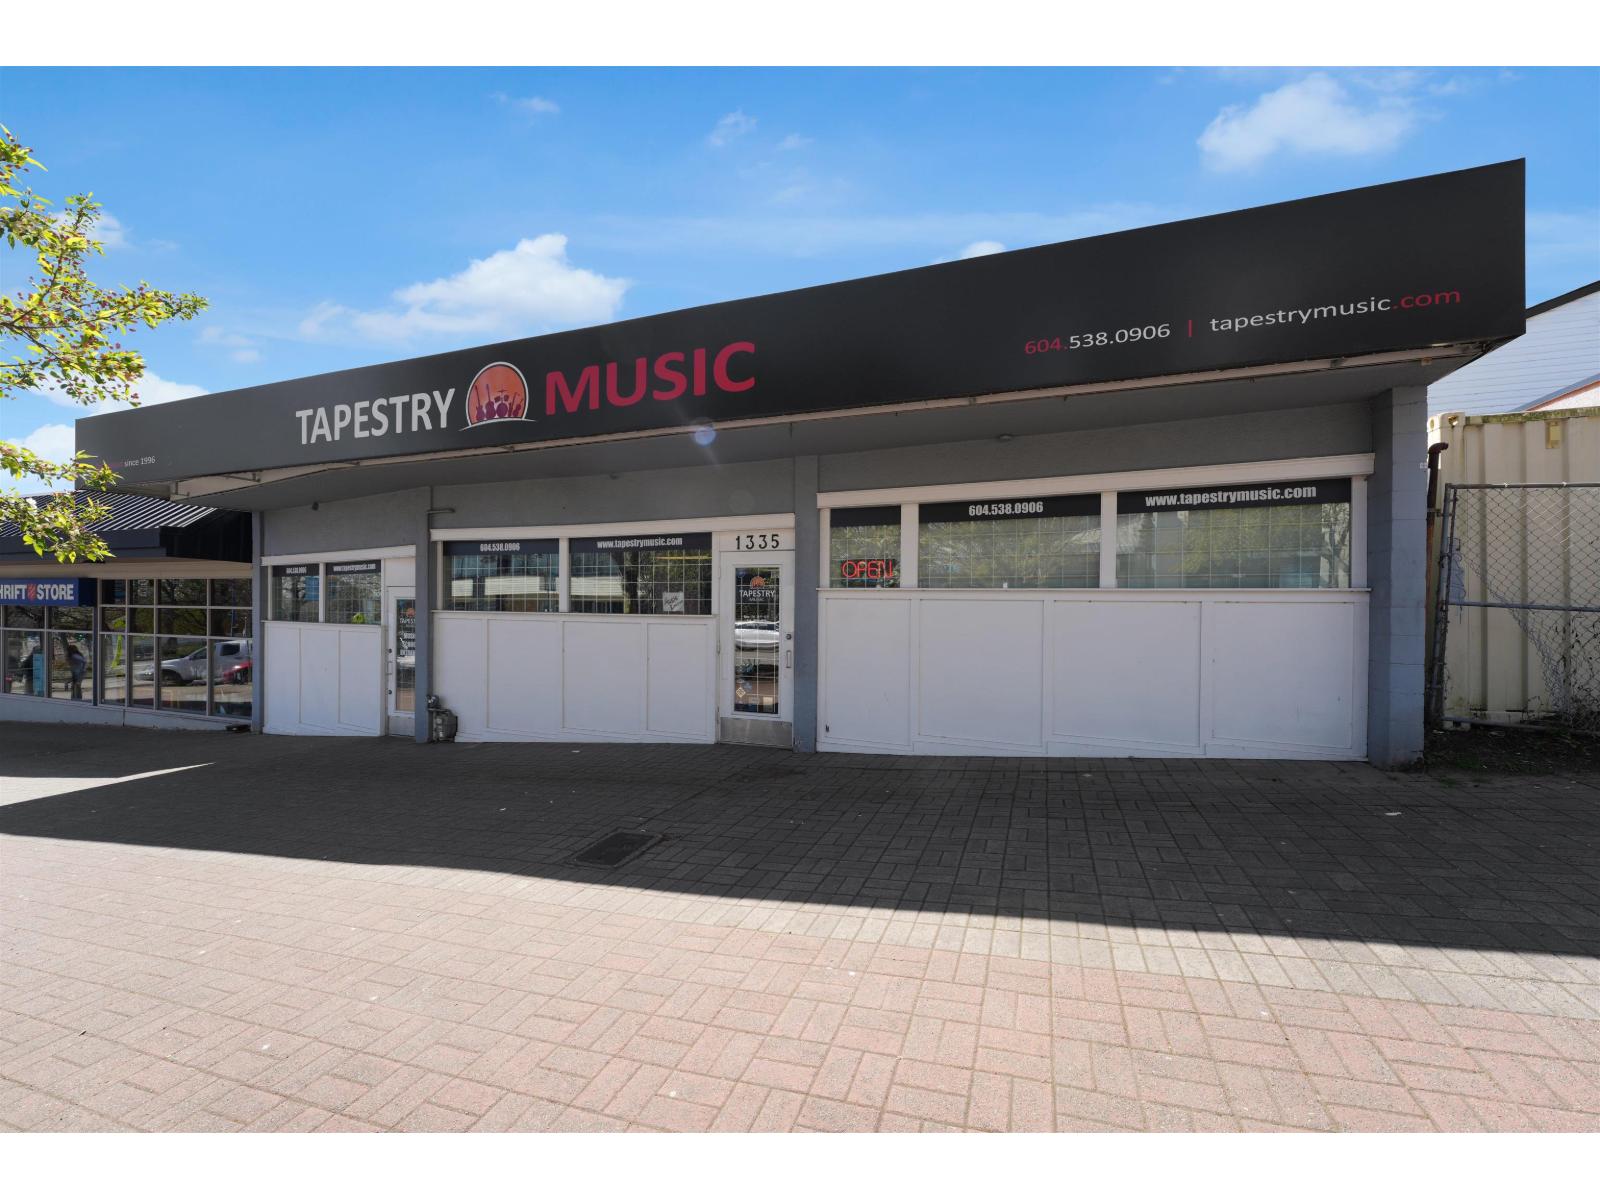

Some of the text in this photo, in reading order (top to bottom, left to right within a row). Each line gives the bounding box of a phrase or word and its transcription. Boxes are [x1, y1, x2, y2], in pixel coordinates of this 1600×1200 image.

[1209, 289, 1462, 332] tapestrymusic.com
[1024, 322, 1171, 355] 604.538.0906
[295, 341, 756, 445] TAPESTRY MUSIC
[124, 456, 156, 467] since 1996
[1145, 484, 1317, 508] www.tapestrymusic.com
[968, 500, 1044, 517] 604.538.0906
[596, 536, 683, 549] www.tapestrymusic.com
[735, 533, 780, 550] 1335
[841, 559, 894, 579] OPEN
[0, 583, 75, 601] HRIFT STORE
[738, 589, 776, 598] TAPESTRY
